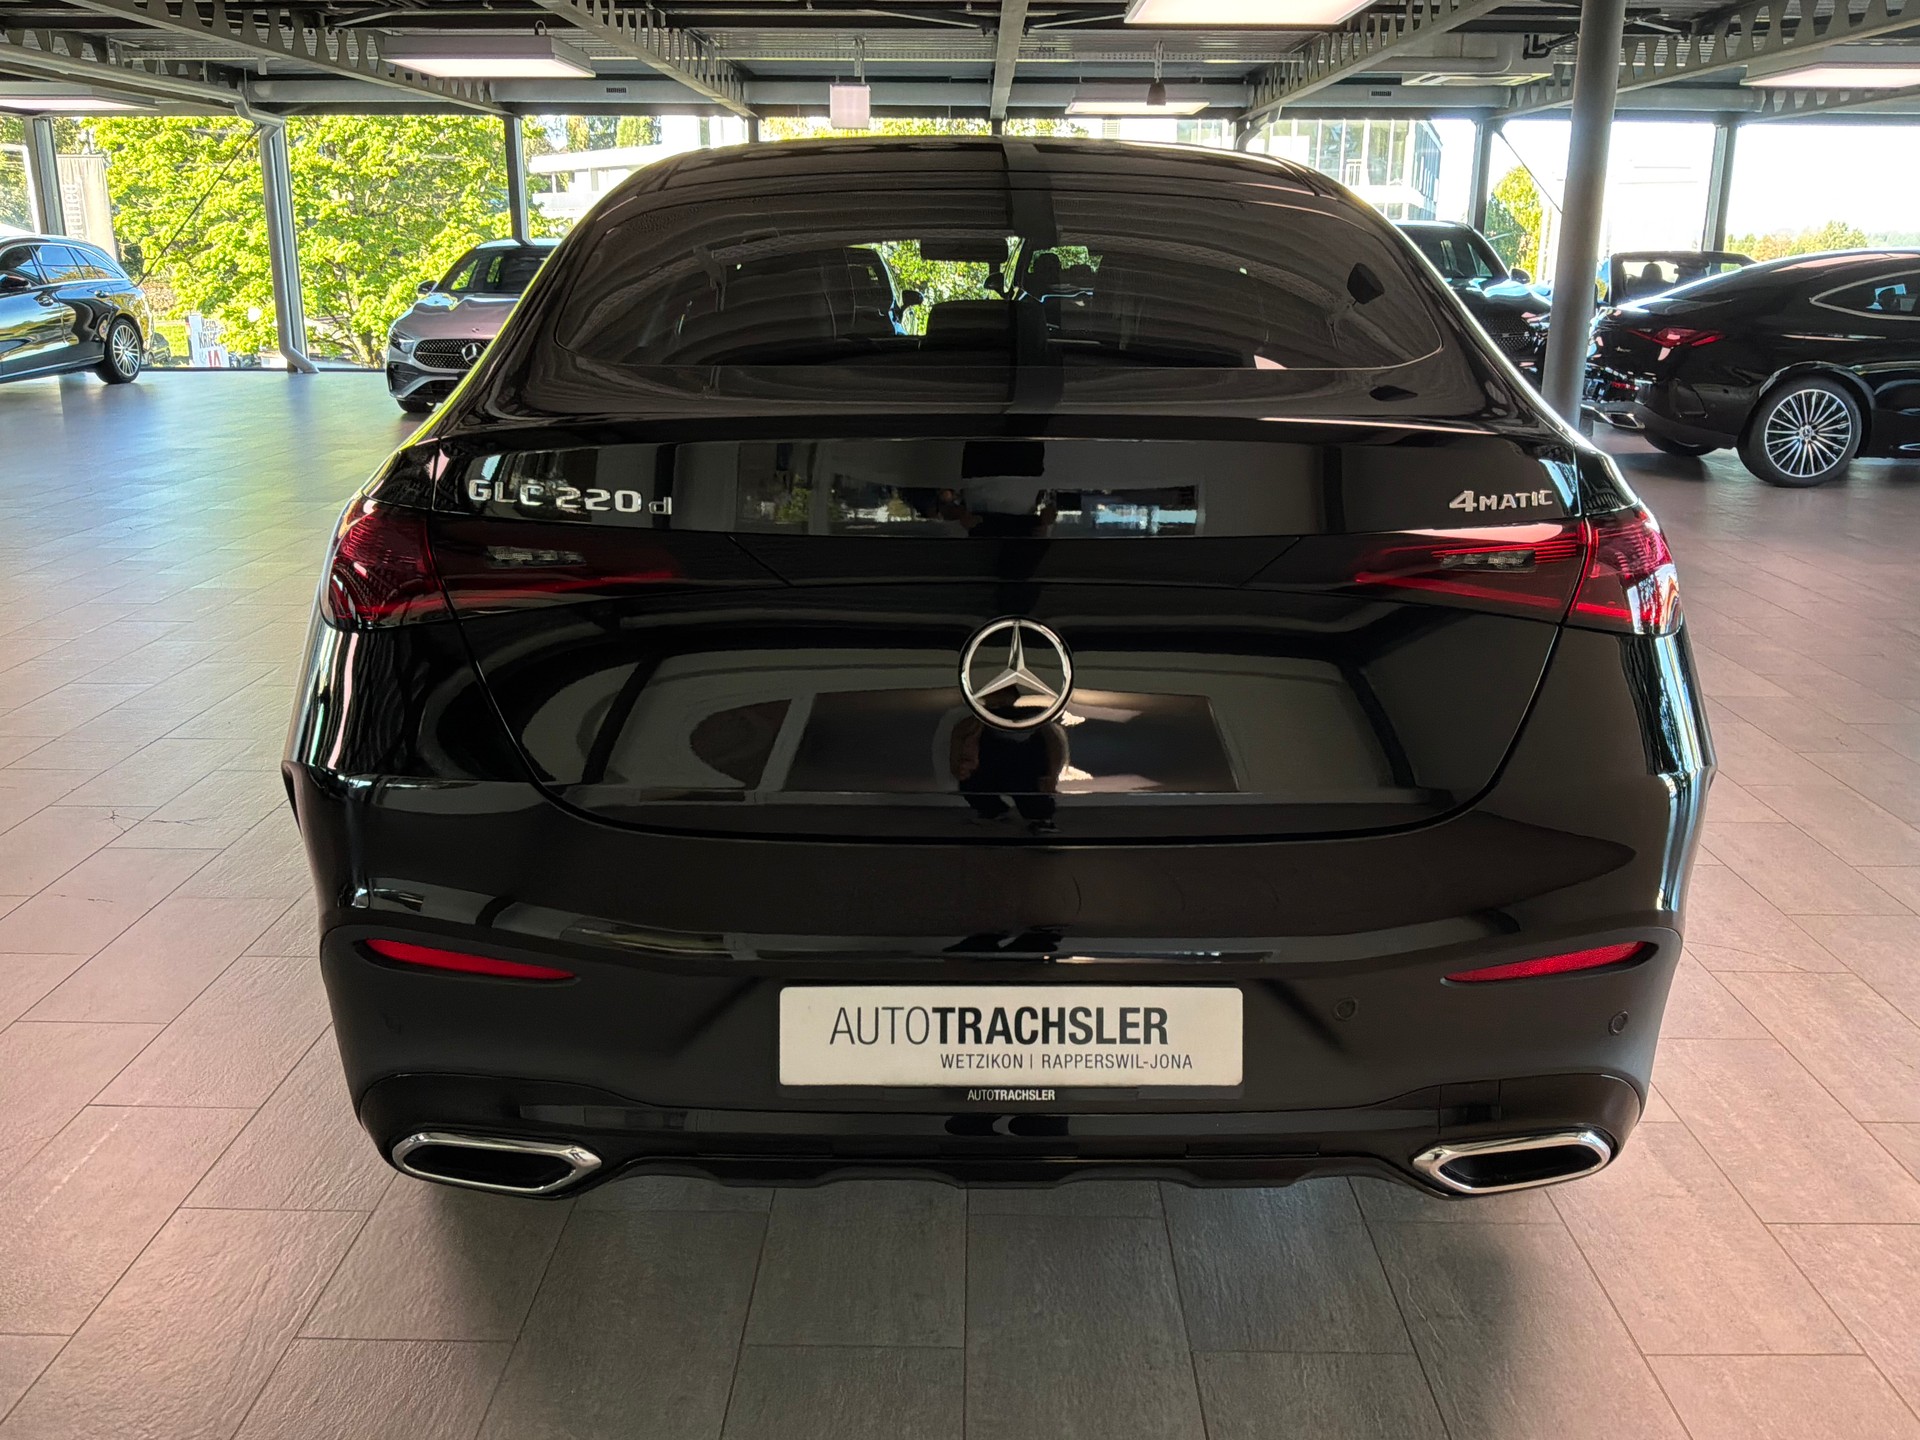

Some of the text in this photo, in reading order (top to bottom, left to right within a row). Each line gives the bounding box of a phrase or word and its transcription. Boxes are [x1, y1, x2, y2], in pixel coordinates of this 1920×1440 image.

[468, 479, 672, 516] GLC 220 d
[1449, 489, 1553, 512] 4MATIC
[829, 1006, 1169, 1046] AUTOTRACHSLER
[940, 1053, 1023, 1070] WETZIKON
[1041, 1053, 1193, 1070] RAPPERSWIL-JONA
[967, 1088, 1056, 1101] AUTOTRACHSLER
